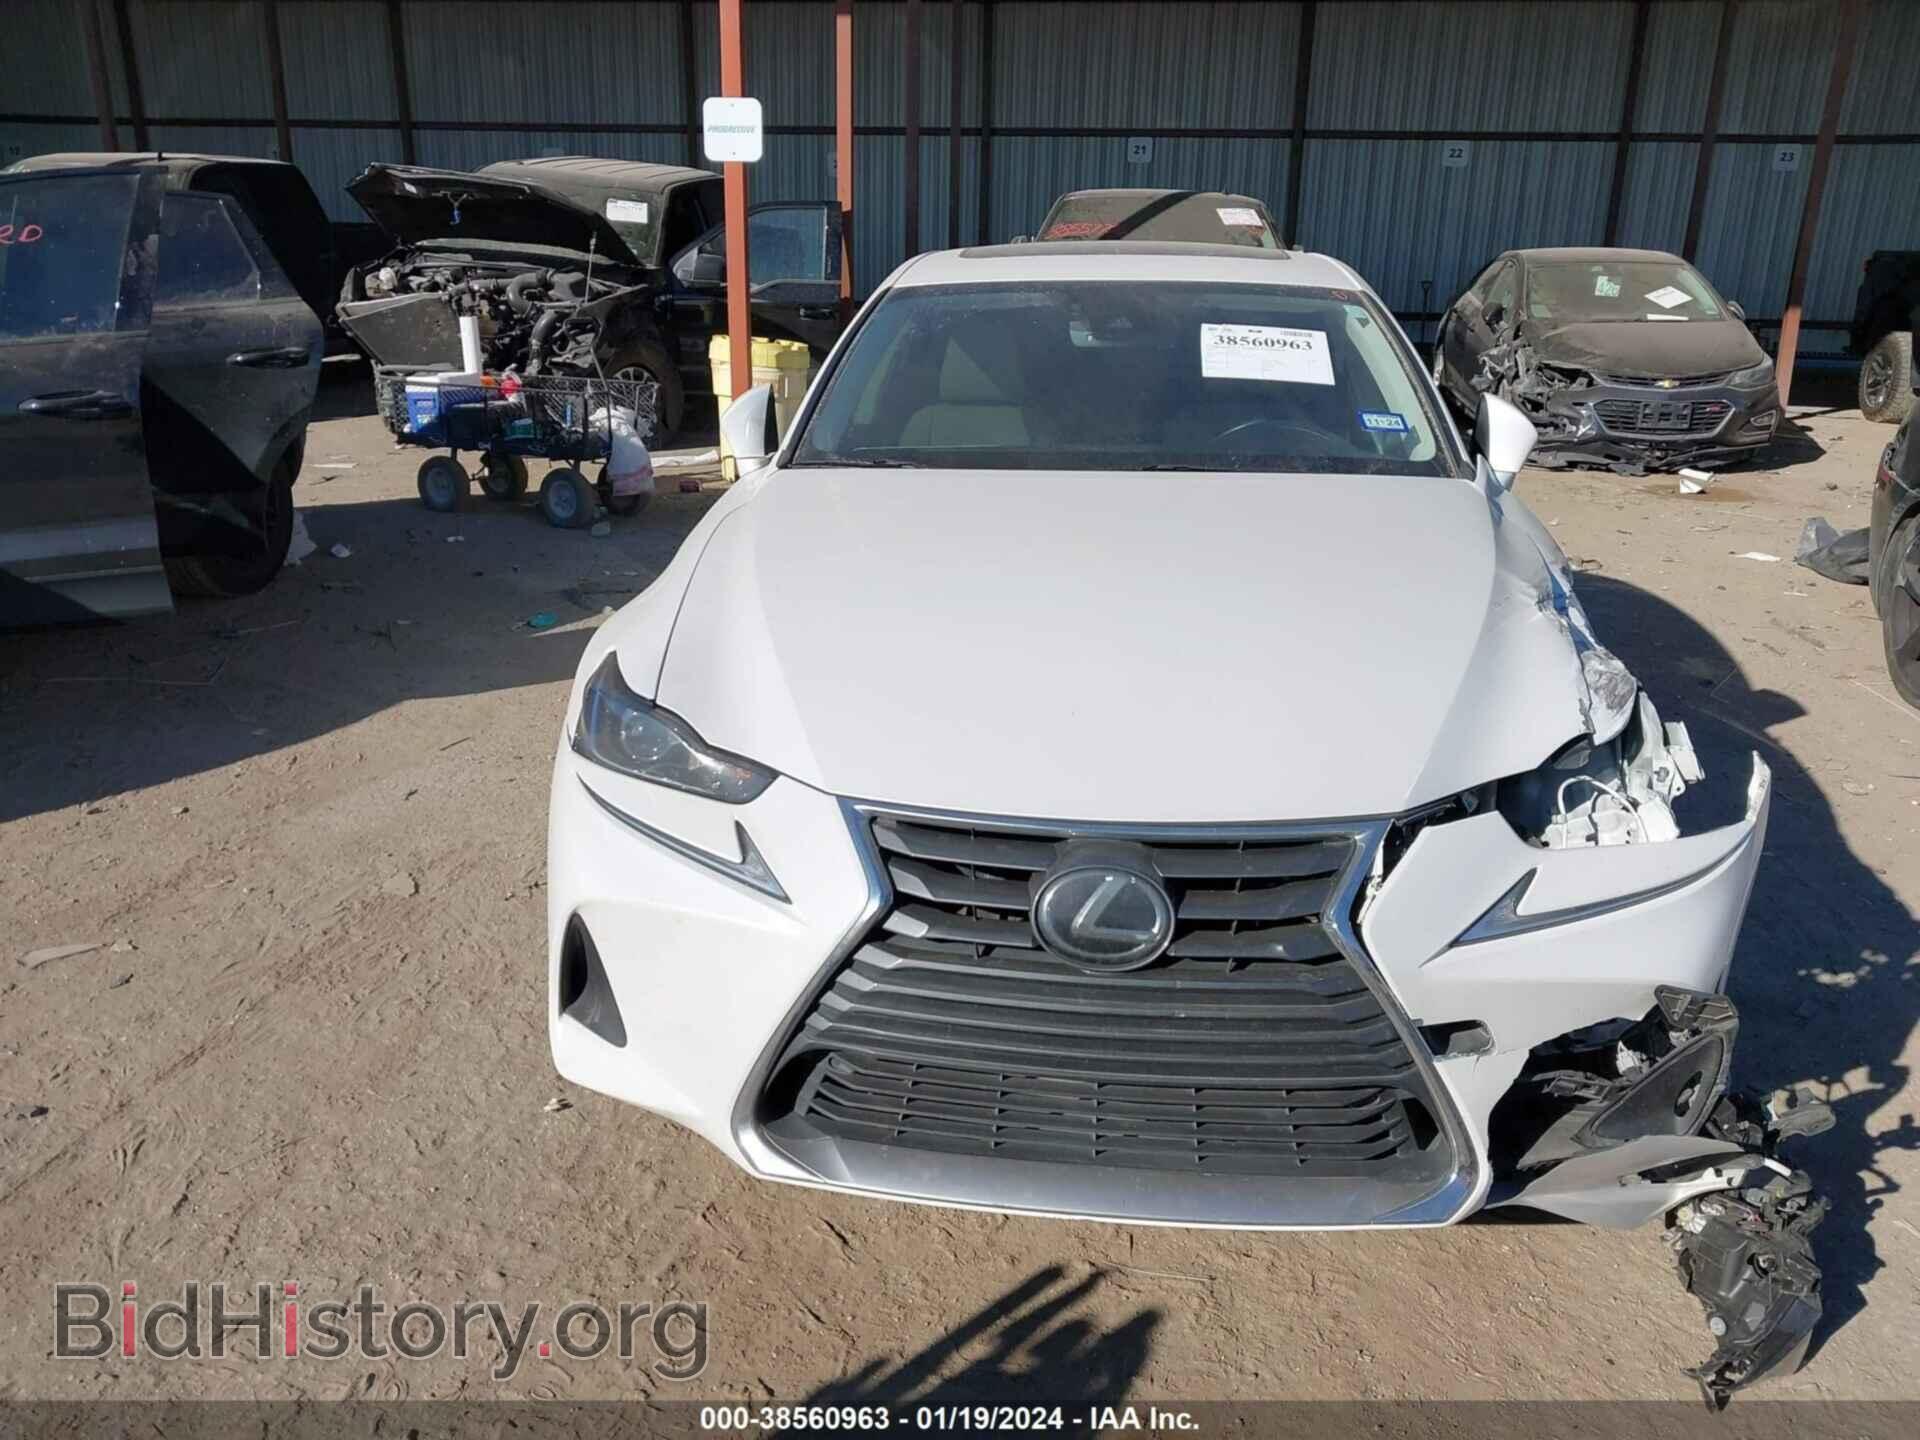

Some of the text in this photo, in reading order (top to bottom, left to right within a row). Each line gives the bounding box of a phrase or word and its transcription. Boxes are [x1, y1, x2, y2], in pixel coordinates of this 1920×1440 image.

[1133, 144, 1147, 155] 21
[1448, 148, 1464, 158] 22
[1780, 152, 1794, 161] 23
[1214, 335, 1313, 351] 38560963
